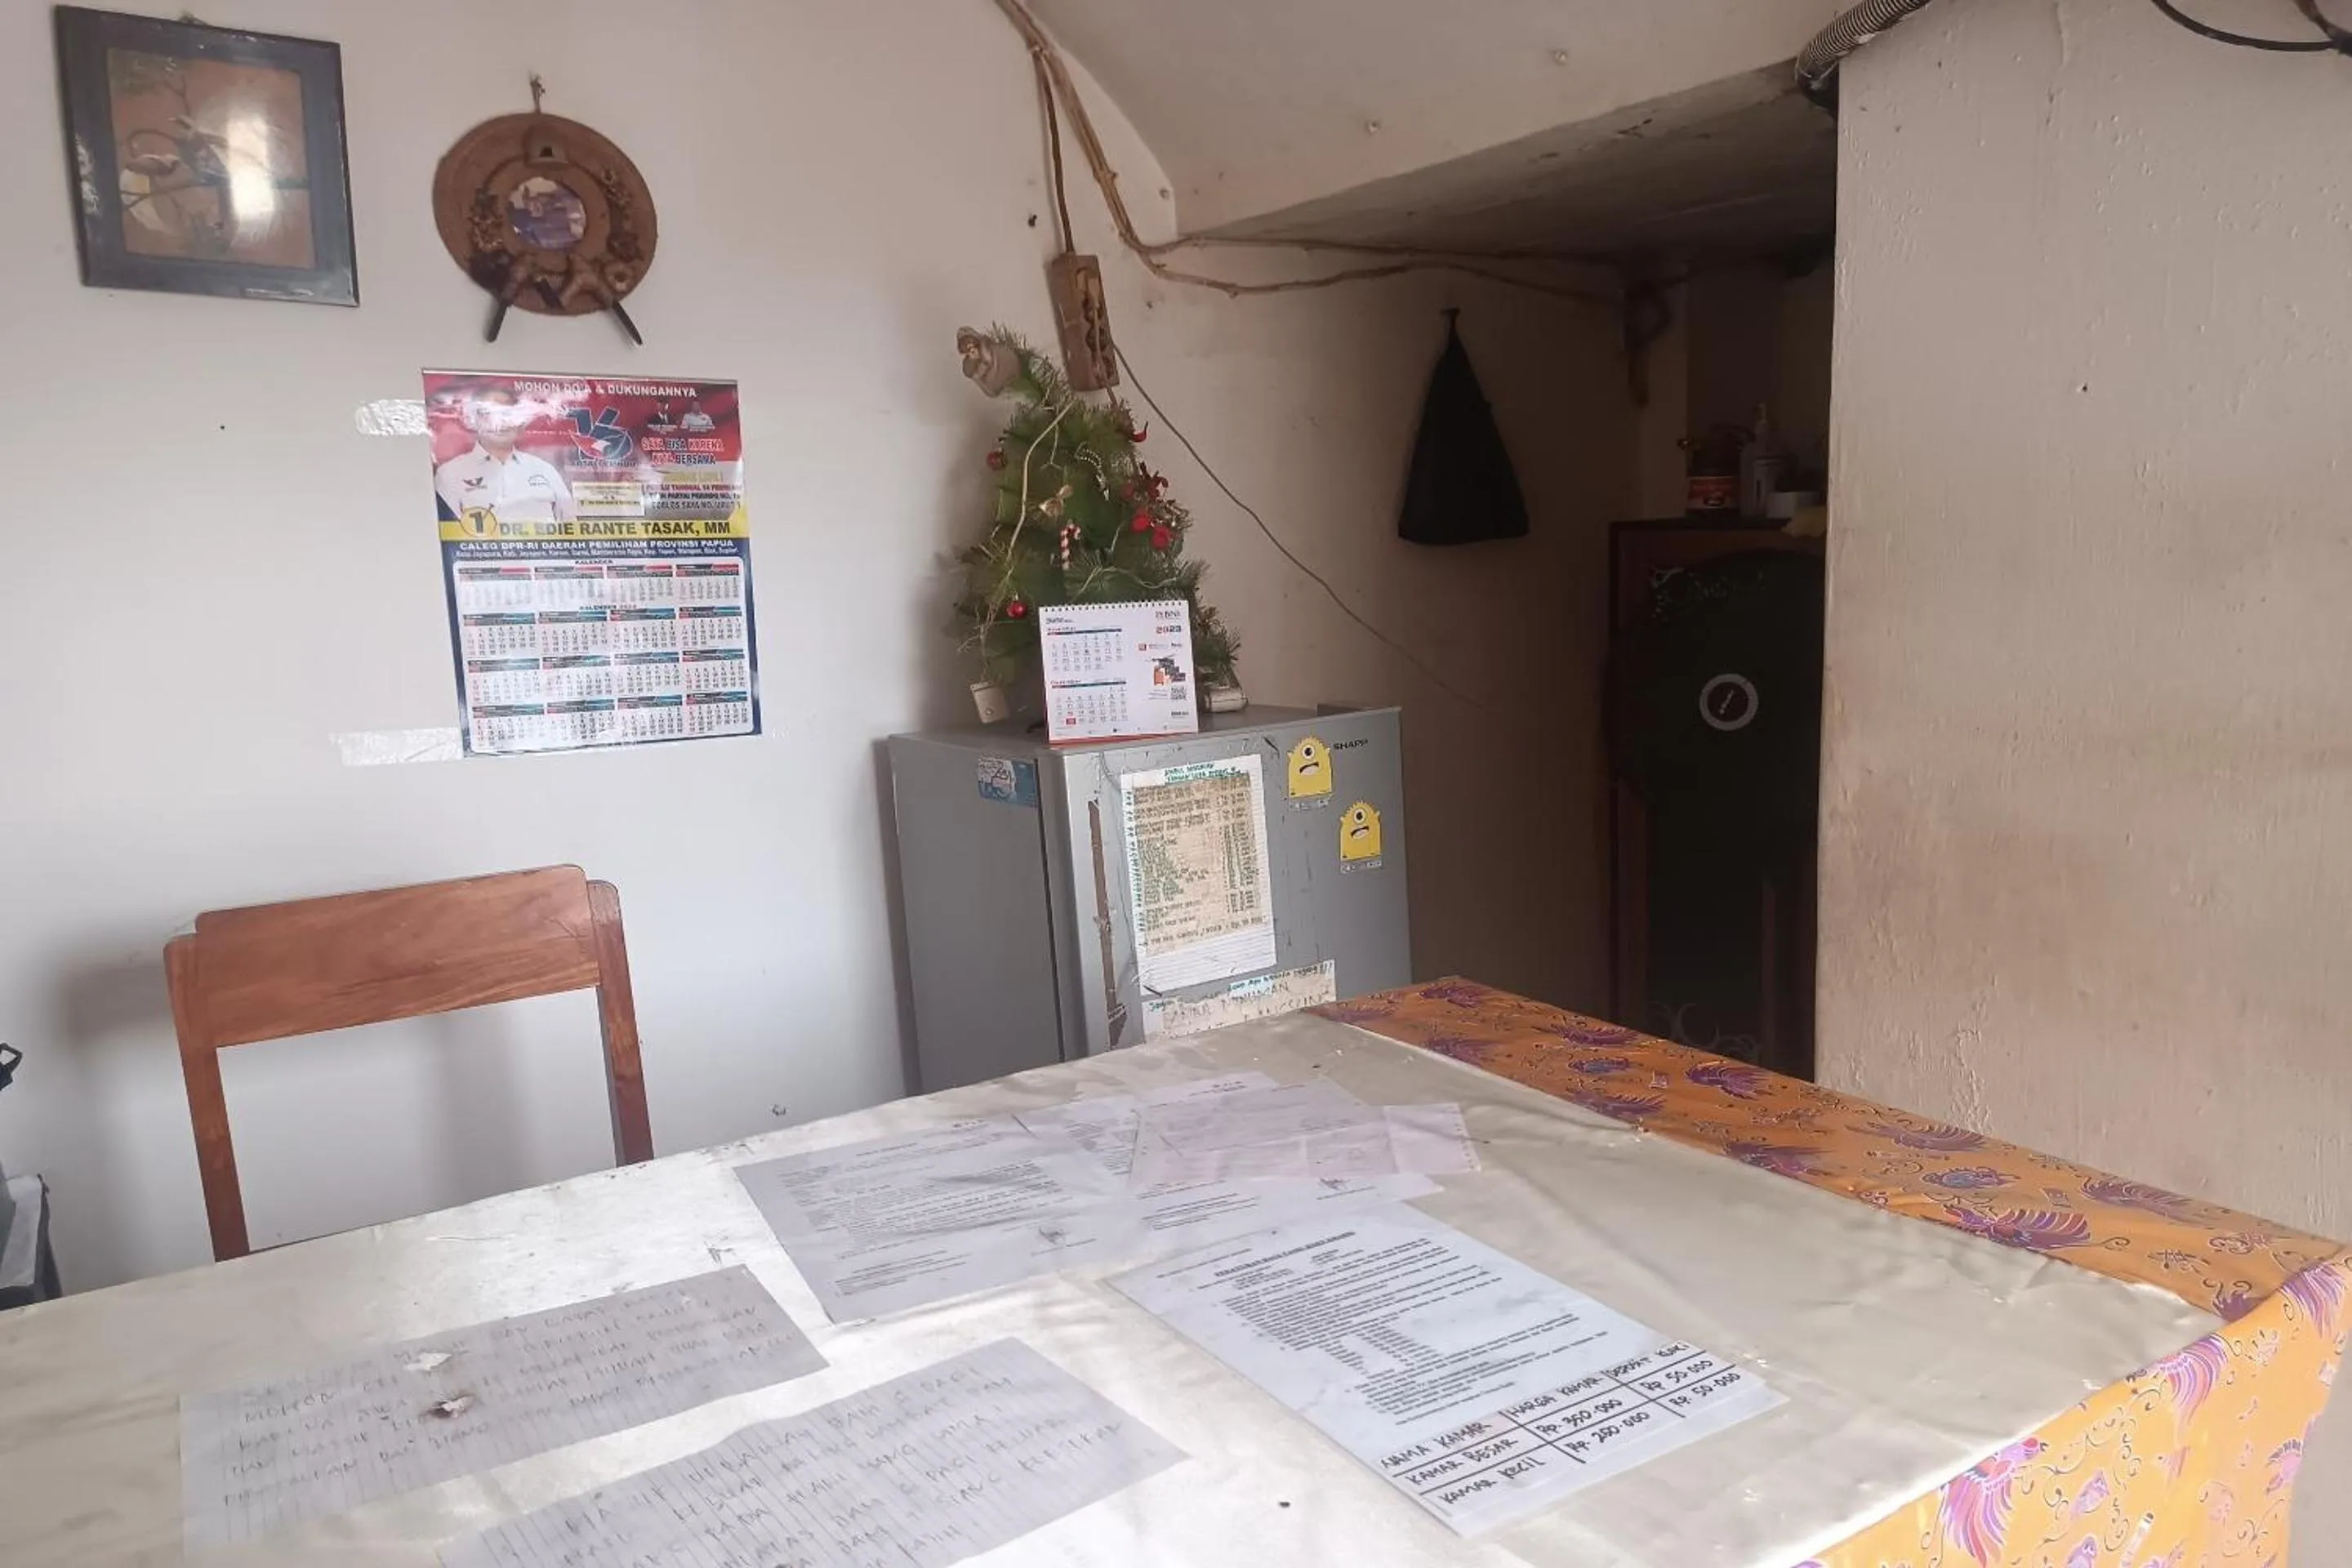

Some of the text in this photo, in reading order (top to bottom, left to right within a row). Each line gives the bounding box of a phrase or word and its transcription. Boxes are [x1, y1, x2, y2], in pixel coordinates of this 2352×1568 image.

[514, 381, 559, 393] MOHON
[608, 384, 697, 398] DUKUNGANNYA
[469, 511, 484, 533] 1
[534, 522, 577, 536] EDIE
[580, 522, 637, 535] RANTE
[641, 522, 700, 537] TASAK,
[705, 521, 730, 533] MM
[1381, 1446, 1430, 1468] NAMA
[1435, 1423, 1491, 1448] KAMAR
[1512, 1396, 1557, 1417] HARGA
[1557, 1371, 1603, 1396] KAMAR
[1405, 1461, 1463, 1485] KAMAR
[1462, 1440, 1518, 1462] BESAR
[1439, 1480, 1497, 1503] KAMAR
[1500, 1457, 1545, 1479] KECIL
